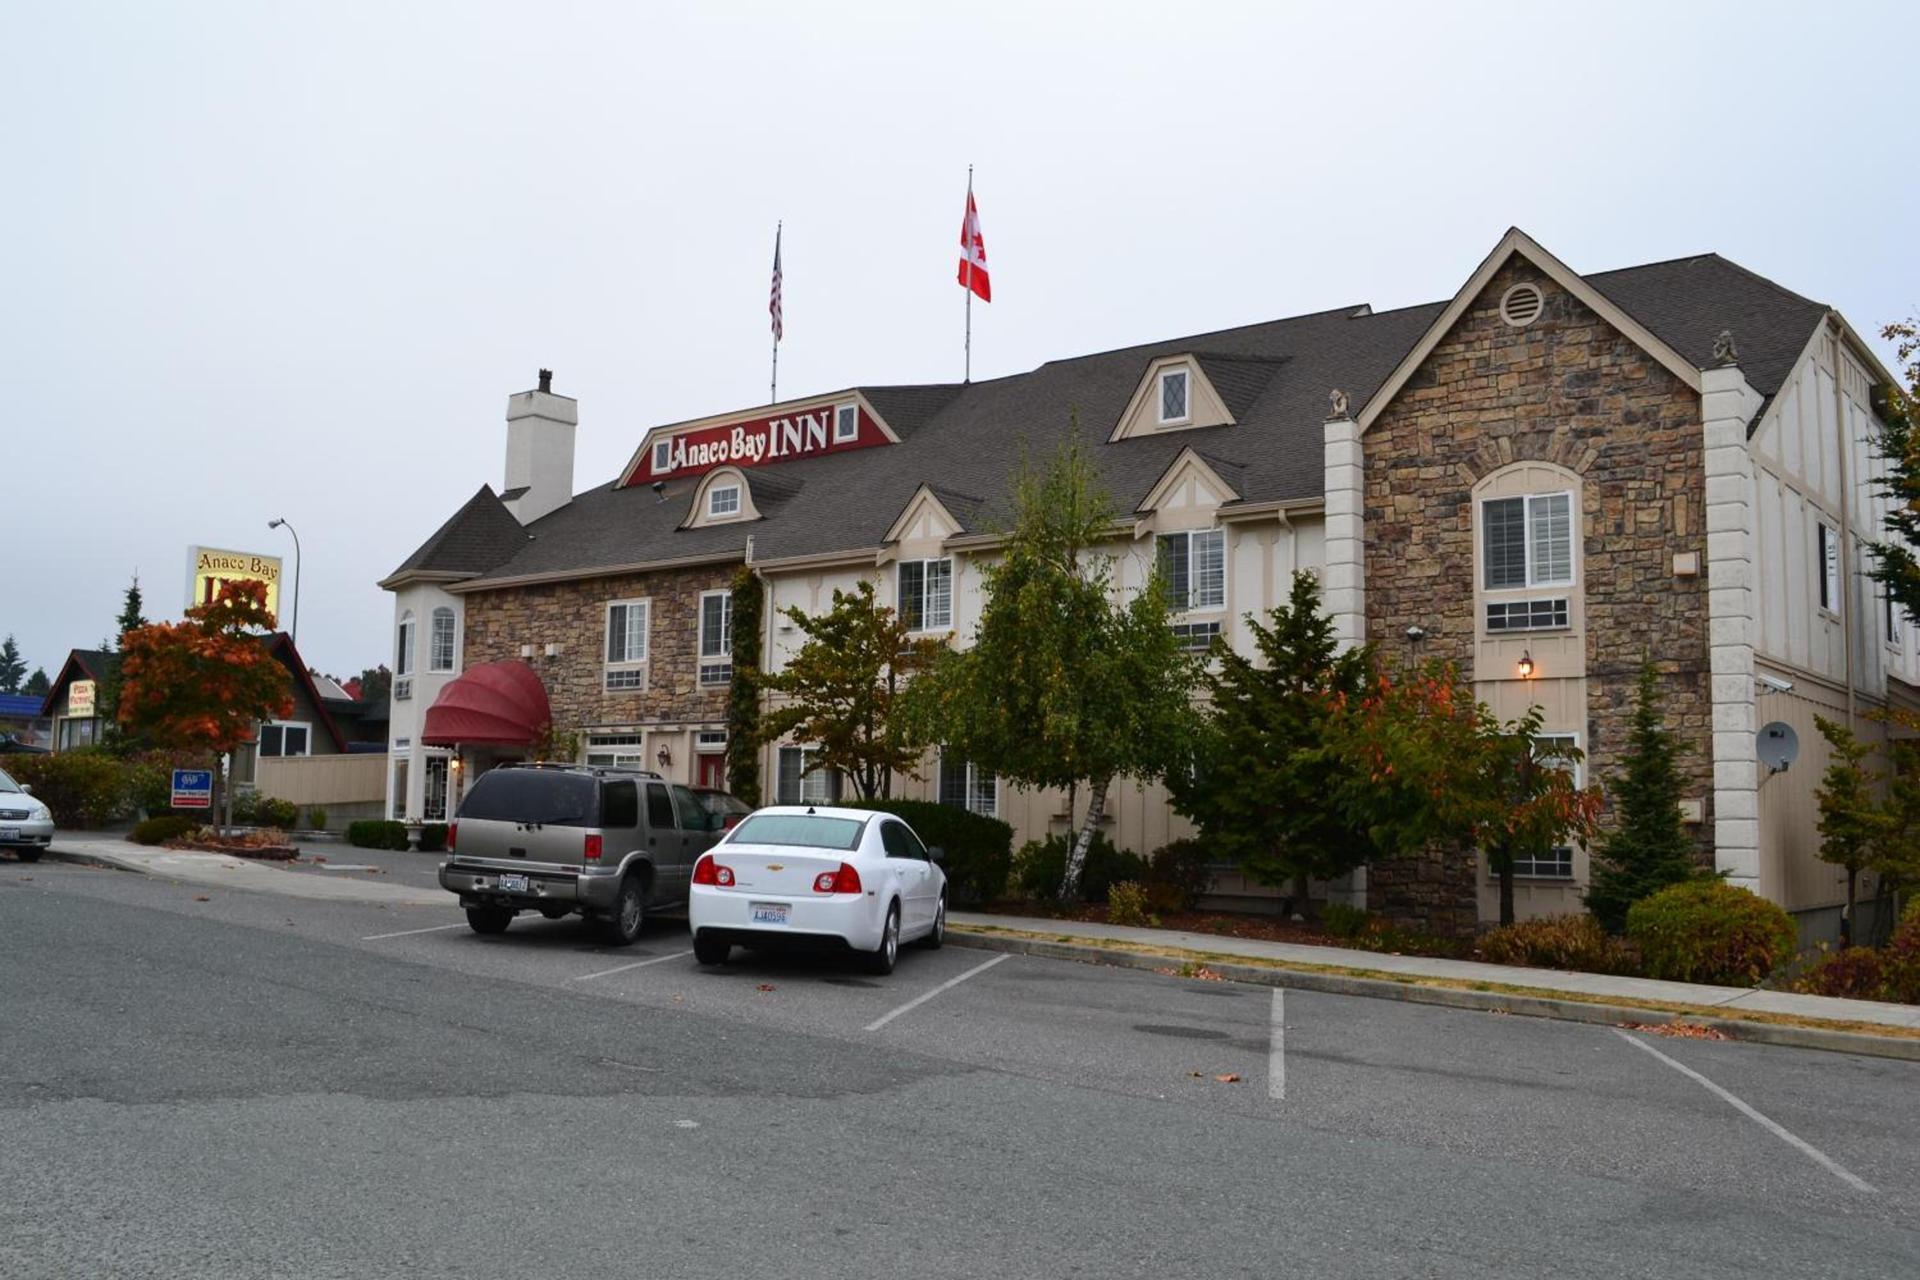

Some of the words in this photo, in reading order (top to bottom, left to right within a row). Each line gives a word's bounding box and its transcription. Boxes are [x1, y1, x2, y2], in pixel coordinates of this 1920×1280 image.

[671, 438, 728, 470] Anaco
[730, 427, 766, 462] Bay
[768, 412, 829, 457] INN
[198, 554, 246, 570] Anaco
[250, 557, 278, 580] Bay
